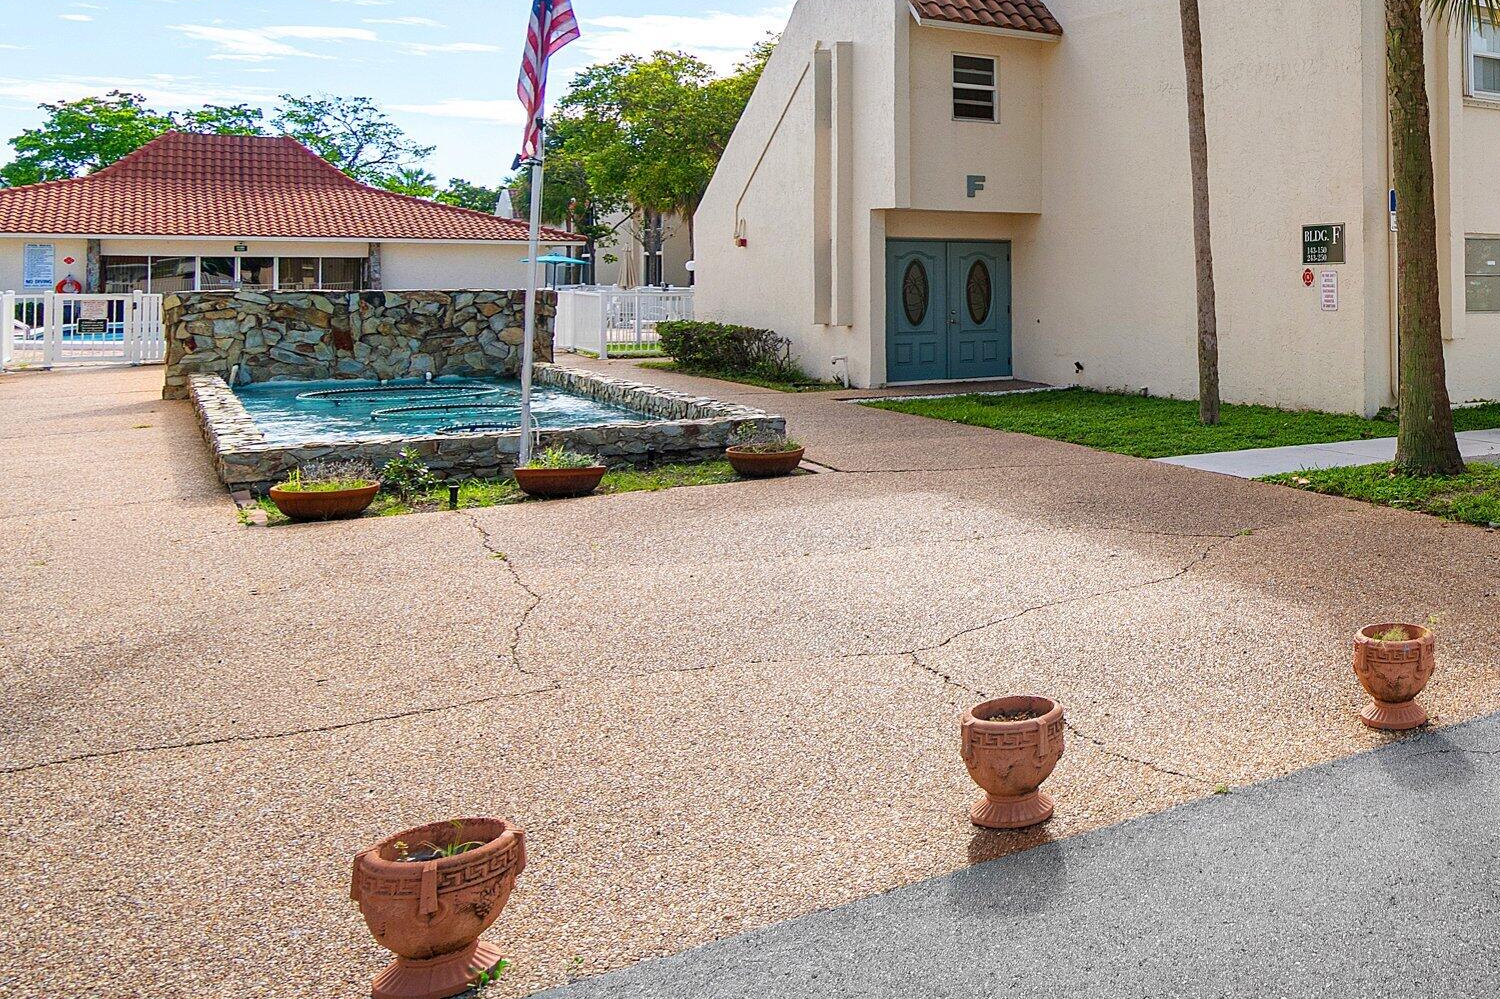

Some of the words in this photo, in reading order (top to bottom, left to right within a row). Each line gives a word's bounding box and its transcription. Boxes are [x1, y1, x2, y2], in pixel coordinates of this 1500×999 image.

[967, 175, 986, 197] F
[1304, 230, 1329, 242] BLDG.
[1332, 226, 1341, 244] F
